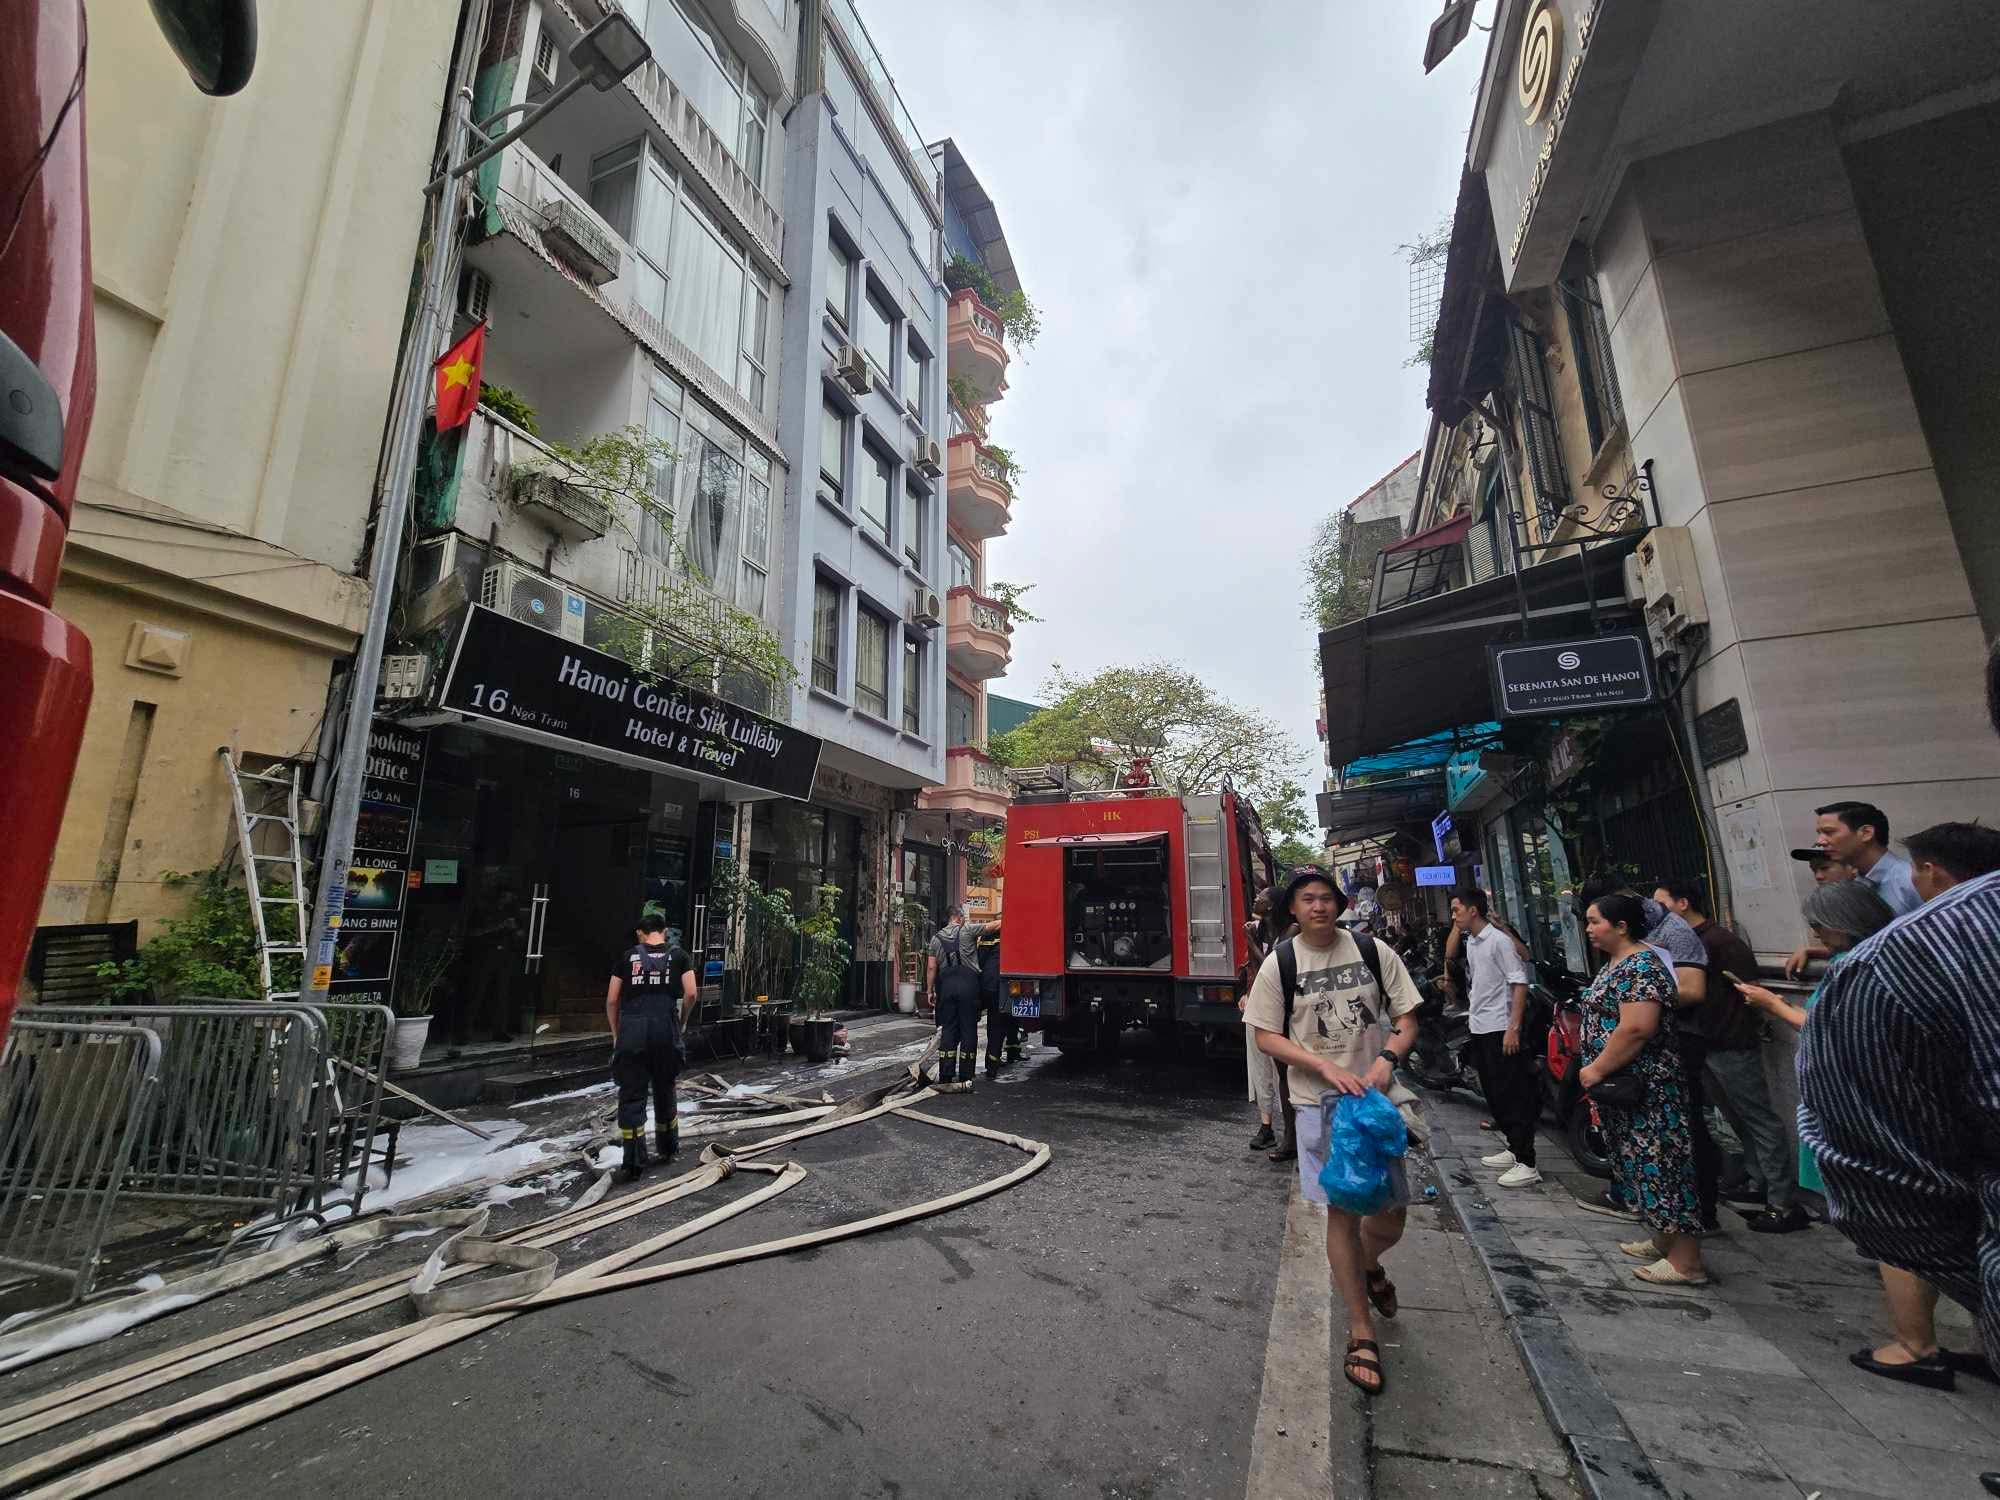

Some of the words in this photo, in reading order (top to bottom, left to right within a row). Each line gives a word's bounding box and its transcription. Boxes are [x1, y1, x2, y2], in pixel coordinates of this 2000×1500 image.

[1507, 680, 1559, 693] SERENATA
[1561, 677, 1582, 687] SAN
[1584, 675, 1599, 685] DE
[1602, 671, 1641, 683] HANOI
[470, 683, 509, 713] 16
[557, 655, 629, 702] Hanoi
[633, 682, 694, 724] Center
[696, 706, 728, 736] Silk
[731, 718, 783, 758] Lullaby
[625, 718, 675, 749] Hotel
[677, 735, 688, 753] &
[691, 738, 738, 767] Travel
[569, 787, 581, 799] 16
[364, 856, 399, 870] LONG
[370, 918, 398, 929] BINH
